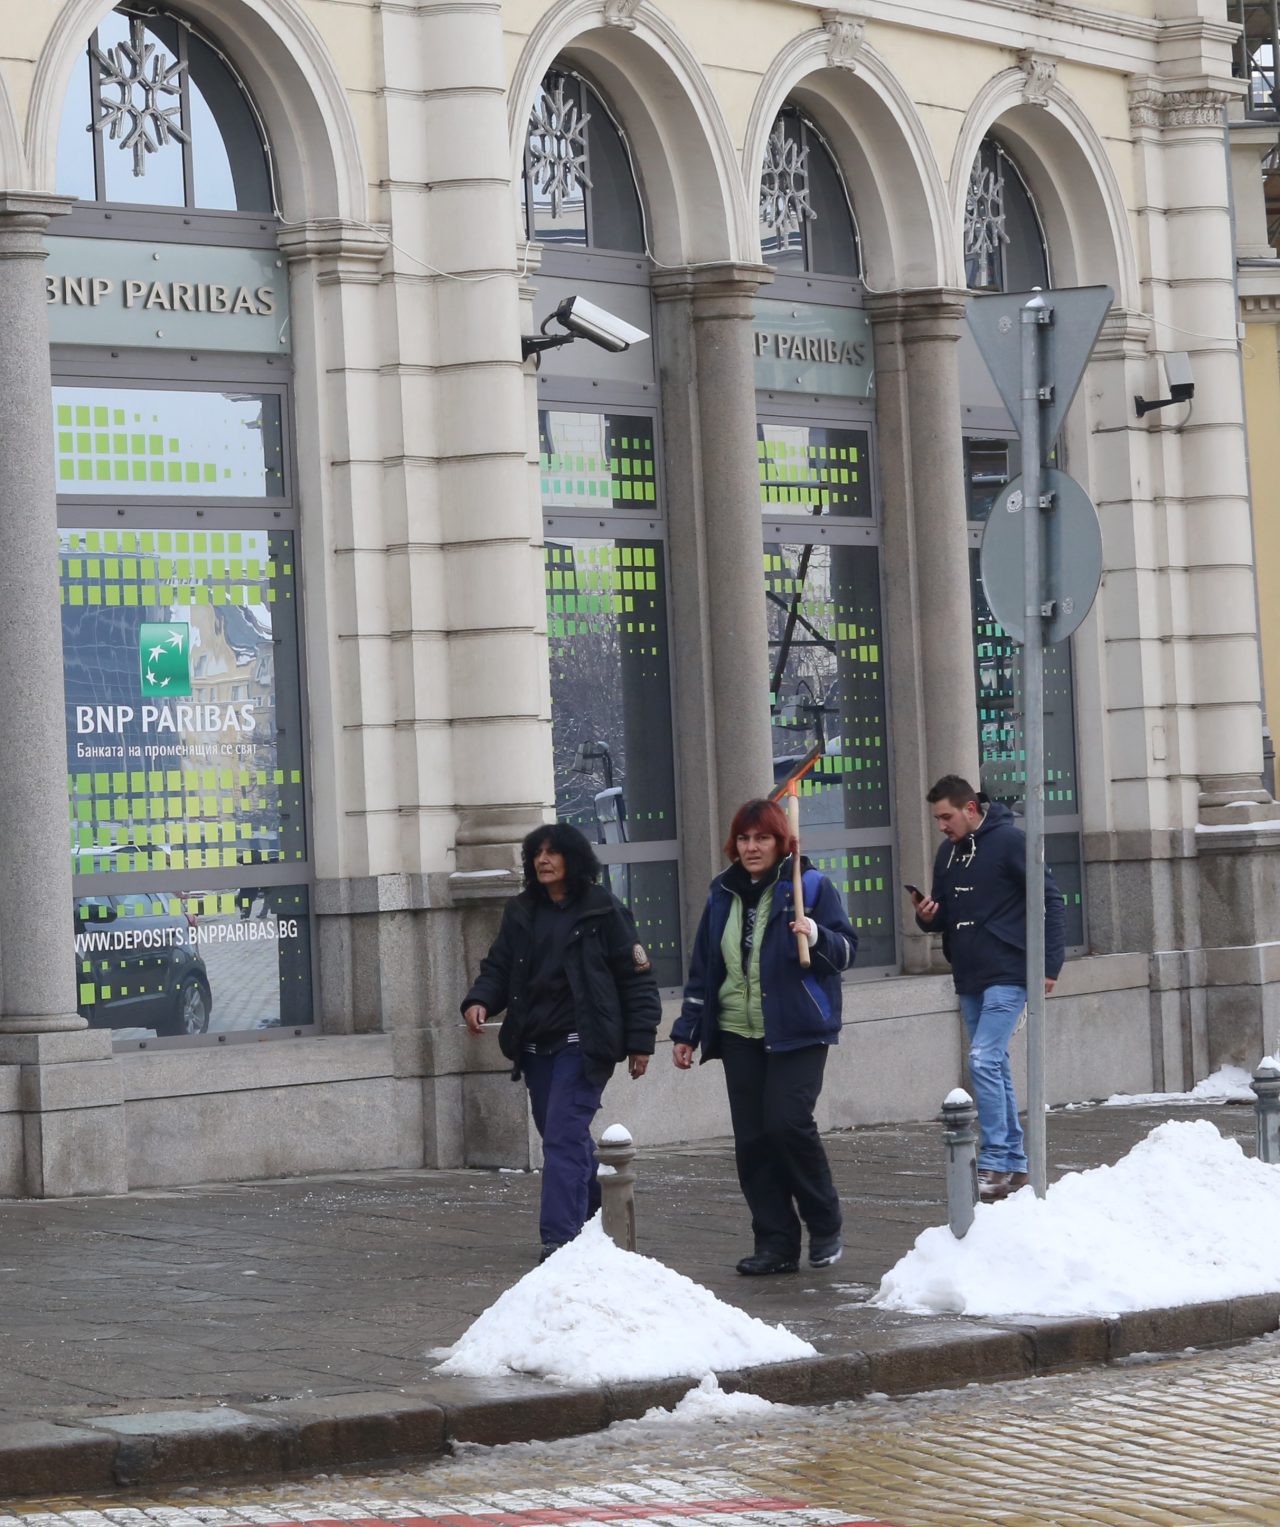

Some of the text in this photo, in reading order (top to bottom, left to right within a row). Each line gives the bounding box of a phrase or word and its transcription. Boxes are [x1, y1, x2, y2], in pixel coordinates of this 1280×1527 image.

[45, 275, 275, 316] BNP PARIBAS
[774, 334, 865, 367] PARIBAS
[76, 704, 256, 734] BNP PARIBAS
[77, 743, 258, 761] Банката на променящия се свят
